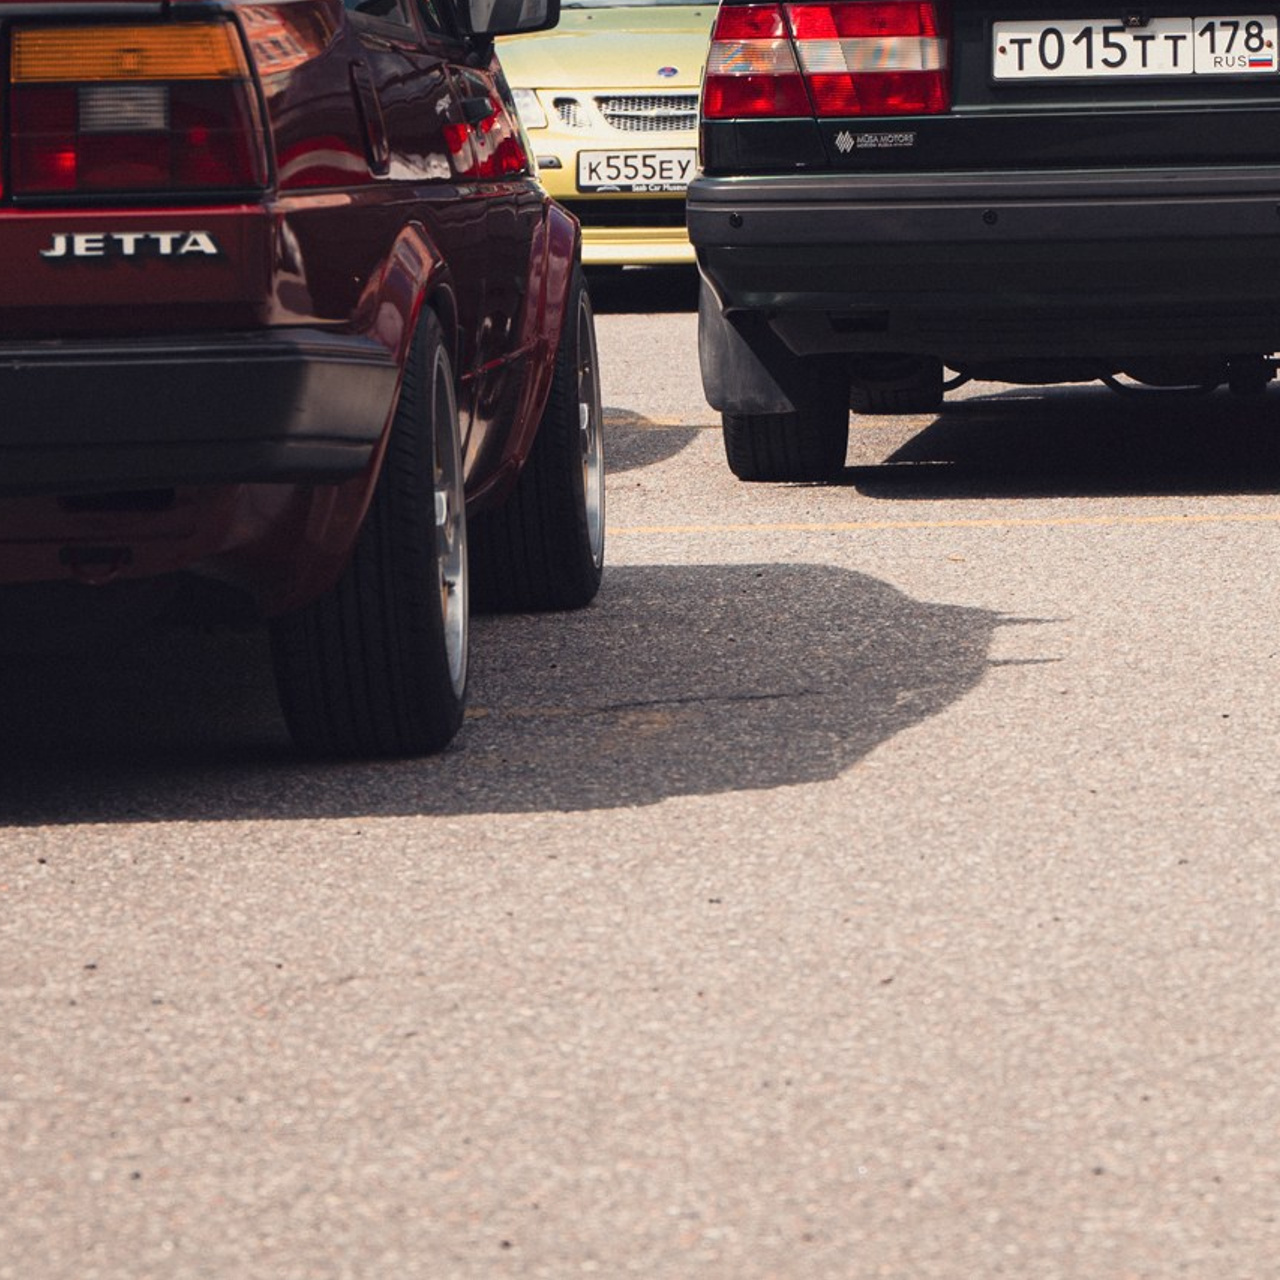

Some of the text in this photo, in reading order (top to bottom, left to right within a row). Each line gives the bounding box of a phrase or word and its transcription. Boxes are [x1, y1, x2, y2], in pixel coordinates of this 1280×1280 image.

[1198, 20, 1265, 54] 178
[1213, 55, 1247, 68] RUS
[40, 231, 219, 257] JETTA
